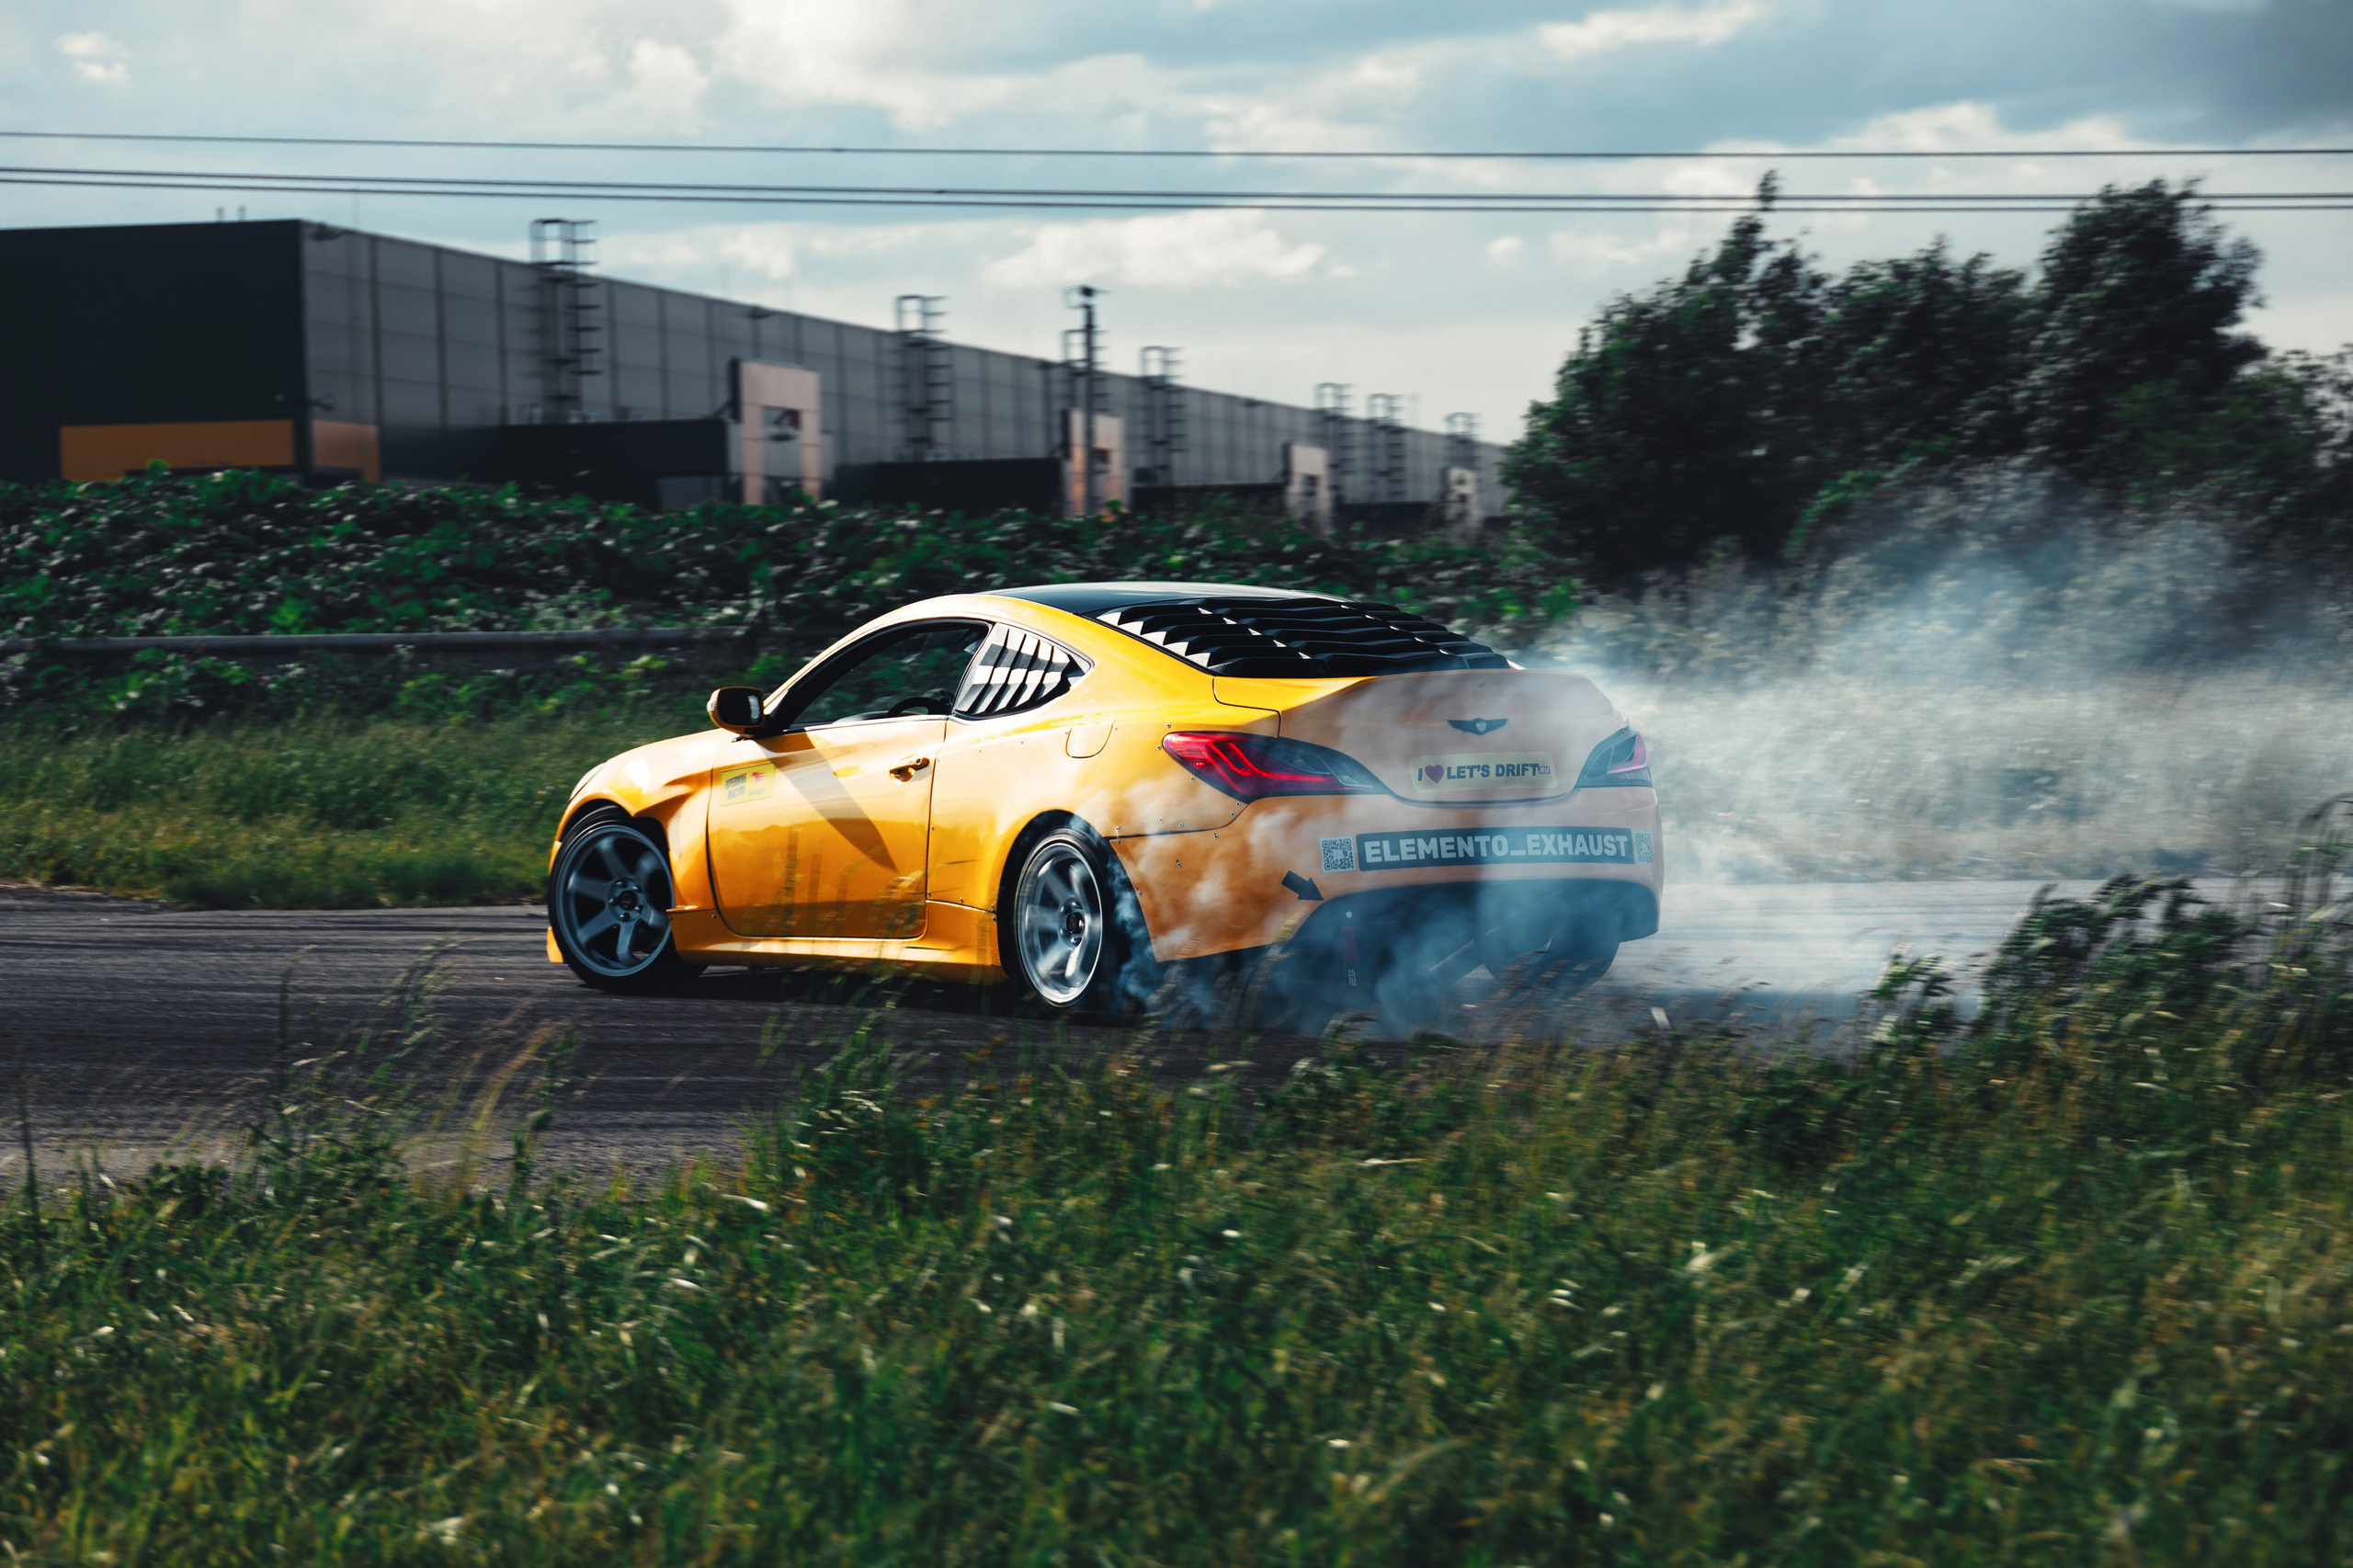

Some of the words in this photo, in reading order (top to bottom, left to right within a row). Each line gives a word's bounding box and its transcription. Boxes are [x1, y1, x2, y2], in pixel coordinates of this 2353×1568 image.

[1417, 767, 1423, 781] I
[1447, 764, 1490, 779] LET’S
[1364, 834, 1628, 863] ELEMENTO_EXHAUST
